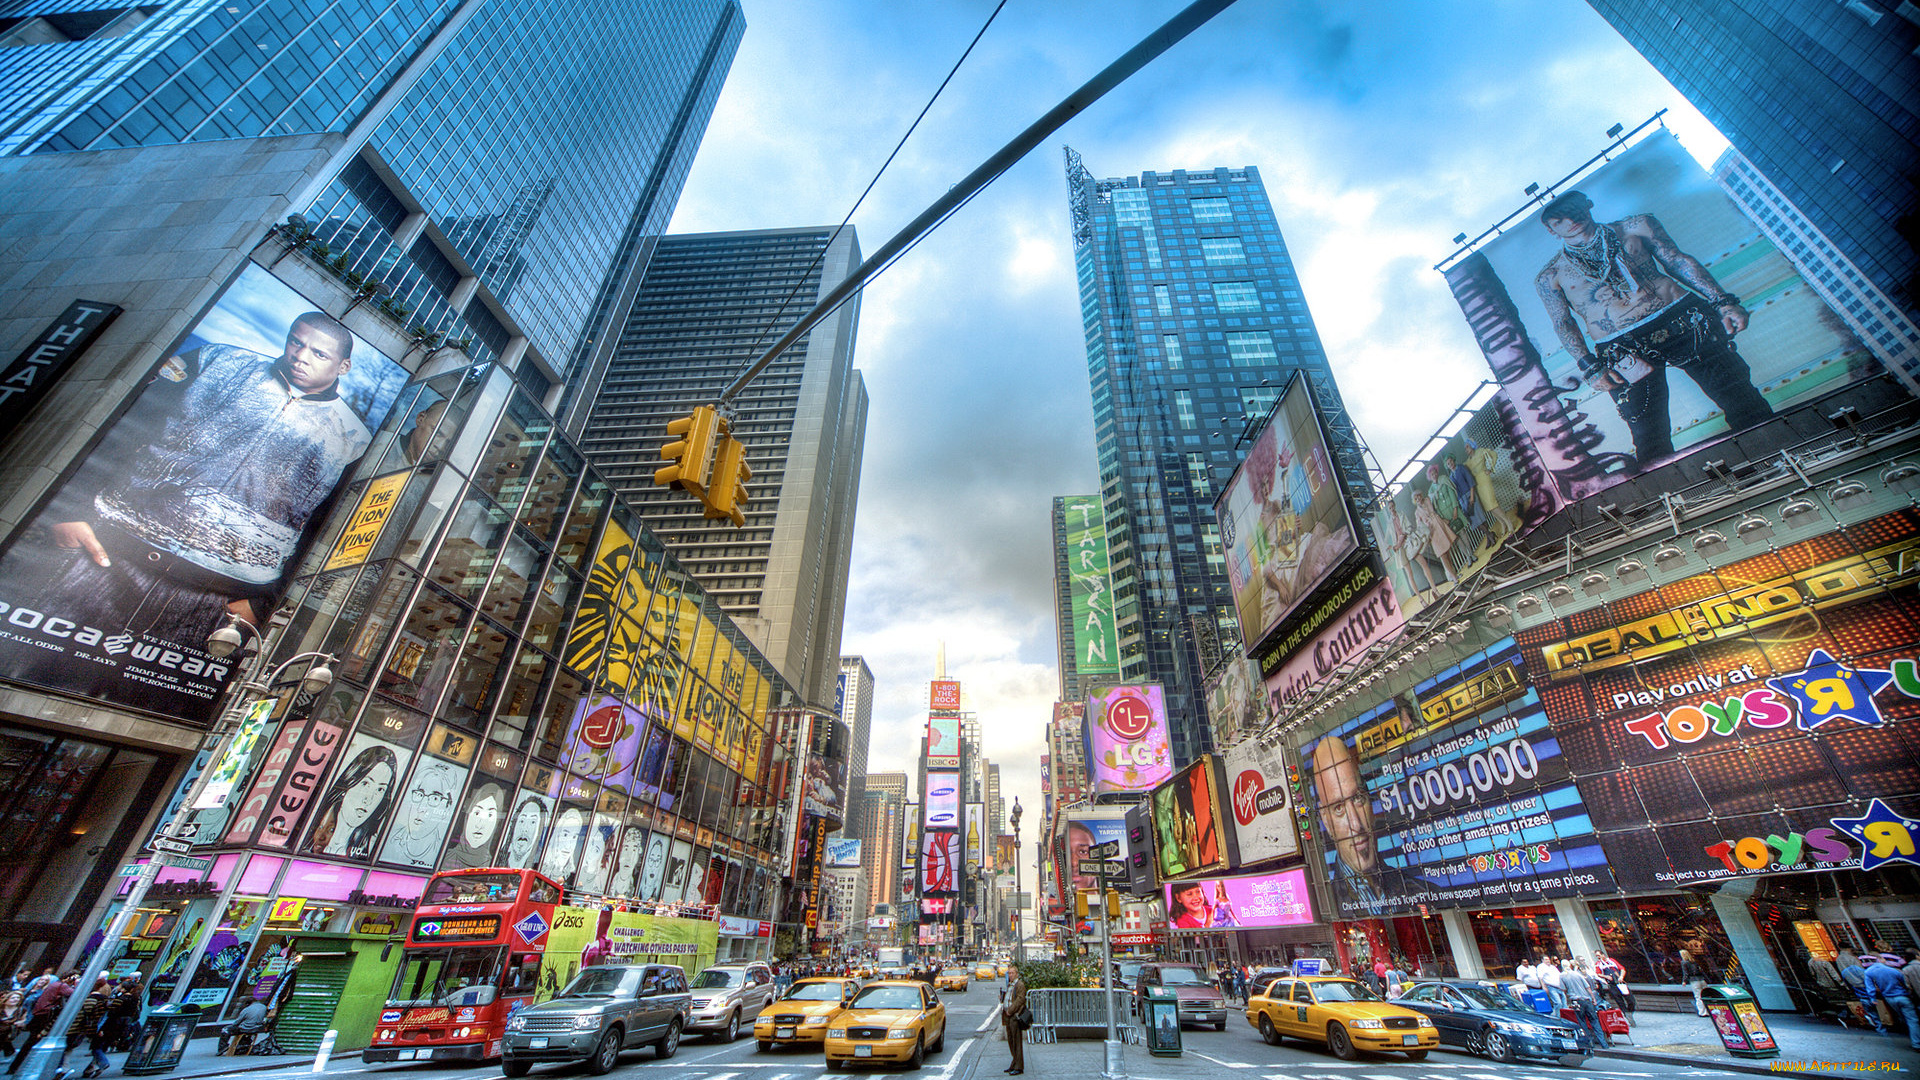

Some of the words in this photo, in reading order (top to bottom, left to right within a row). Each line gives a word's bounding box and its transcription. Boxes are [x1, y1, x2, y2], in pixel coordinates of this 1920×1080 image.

[370, 489, 394, 506] THE
[350, 506, 388, 533] LION
[335, 530, 375, 558] KING
[1262, 657, 1279, 673] BORN
[1279, 649, 1288, 661] IN
[1288, 633, 1302, 650] THE
[1301, 584, 1352, 637] GLAMOROUS
[1352, 566, 1374, 592] USA
[1313, 586, 1397, 677] Couture
[1557, 619, 1684, 670] DEAL
[1712, 585, 1803, 626] NO
[14, 633, 34, 646] ALL
[35, 639, 65, 653] ODDS
[74, 650, 91, 661] DR.
[93, 654, 117, 667] JAYS
[126, 664, 156, 678] JIMMY
[157, 672, 179, 684] JAZZ
[186, 680, 218, 693] MACY'S
[142, 633, 160, 645] WE
[162, 637, 182, 649] RUN
[183, 642, 201, 655] THE
[203, 651, 233, 665] STRIP
[123, 671, 214, 700] WWW.ROCAWEAR.COM
[1612, 685, 1666, 710] Play
[1668, 673, 1724, 698] only
[1728, 663, 1757, 685] at
[1624, 688, 1793, 751] TOYS
[384, 716, 403, 731] we
[495, 757, 508, 770] all
[570, 785, 591, 798] speak
[442, 732, 465, 757] MTV
[1114, 742, 1153, 767] LG
[1382, 762, 1403, 777] Play
[1404, 755, 1421, 768] for
[1421, 754, 1430, 762] a
[1431, 736, 1474, 759] chance
[1475, 727, 1491, 740] to
[1492, 716, 1520, 735] win
[928, 758, 948, 766] HSBC
[233, 726, 304, 834] PEACE
[268, 728, 336, 837] PEACE
[1379, 738, 1539, 820] $1,000,000
[1235, 775, 1259, 820] Virgin
[1258, 789, 1283, 811] mobile
[1399, 829, 1409, 838] or
[1417, 822, 1433, 836] trip
[1433, 819, 1445, 831] to
[1446, 816, 1462, 829] the
[1464, 808, 1495, 824] show,
[1496, 806, 1508, 816] or
[1512, 798, 1537, 812] over
[157, 839, 169, 848] ONE
[174, 843, 187, 851] WAY
[814, 818, 826, 863] KODAK
[1401, 839, 1436, 854] 100,000
[1438, 833, 1462, 846] other
[1464, 822, 1510, 841] amazing
[1511, 812, 1552, 832] prizes!
[172, 858, 209, 869] BROADWAY
[1424, 867, 1441, 878] Play
[1441, 864, 1456, 876] only
[1458, 863, 1466, 873] at
[1467, 851, 1505, 874] TOYS
[1529, 844, 1552, 863] US
[1704, 827, 1853, 873] TOYS
[1105, 864, 1120, 872] WAY
[1655, 871, 1694, 882] Subject
[1695, 870, 1707, 879] to
[809, 865, 821, 908] digital
[1439, 888, 1482, 902] newspaper
[1483, 883, 1508, 896] insert
[1509, 881, 1522, 892] for
[1524, 883, 1530, 891] a
[1532, 877, 1562, 892] game
[1563, 873, 1600, 889] piece.
[276, 901, 297, 917] MTV
[479, 918, 497, 928] LOOP
[563, 916, 584, 928] asics
[475, 926, 495, 935] CENTER
[613, 927, 645, 937] CHALLENGE:
[1120, 935, 1146, 944] swatch
[614, 942, 650, 954] WATCHING
[650, 942, 673, 953] OTHERS
[673, 943, 687, 953] PASS
[687, 943, 698, 954] YOU
[398, 1007, 451, 1031] Broadway
